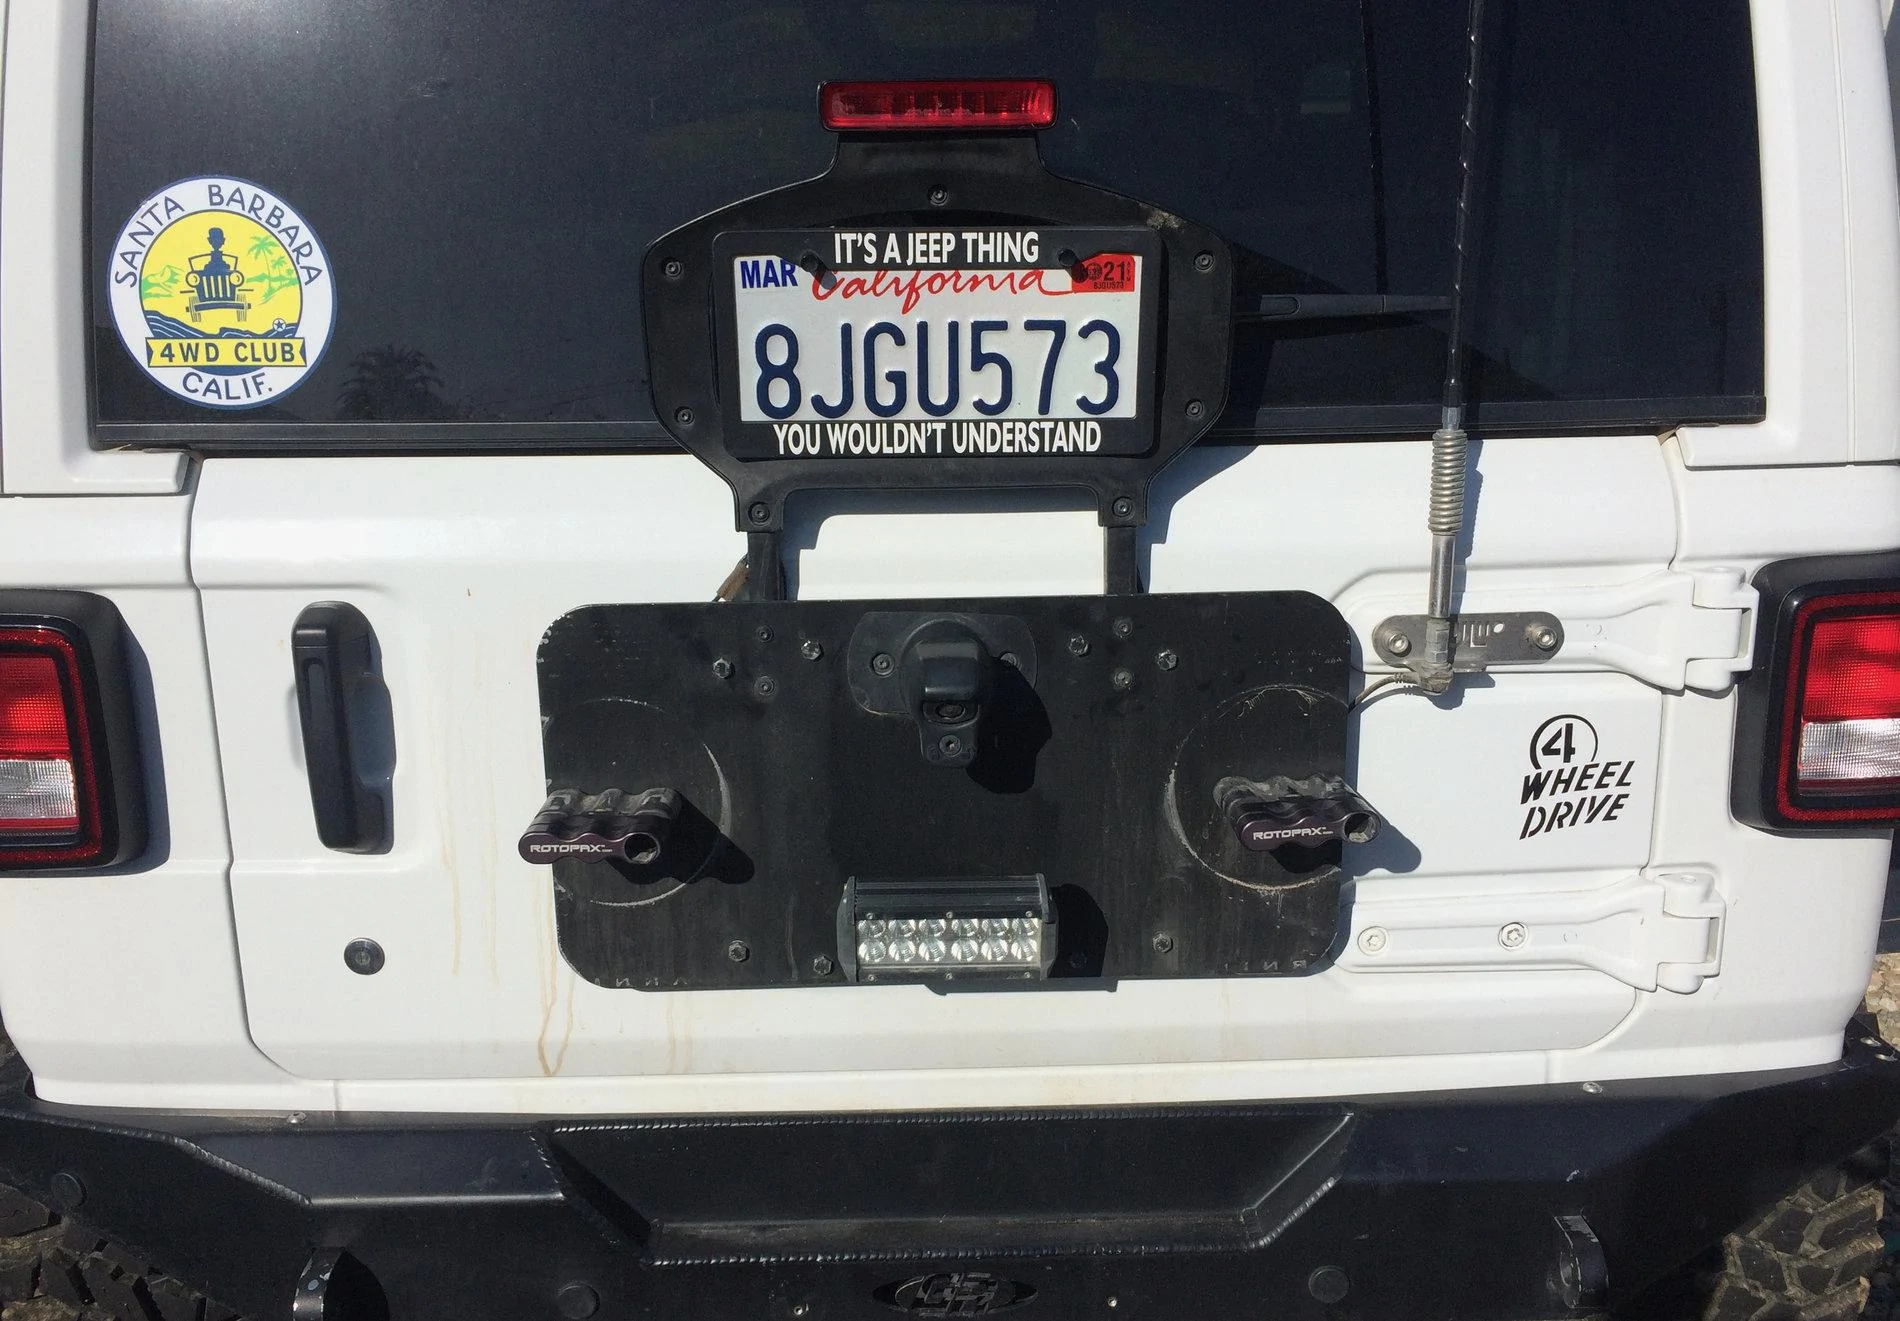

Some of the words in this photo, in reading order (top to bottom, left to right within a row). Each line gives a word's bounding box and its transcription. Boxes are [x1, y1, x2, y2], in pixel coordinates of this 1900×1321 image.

[115, 196, 185, 288] SANTA
[207, 184, 323, 286] BARBARA
[834, 234, 876, 264] IT'S
[883, 233, 902, 263] A
[906, 233, 954, 265] JEEP
[961, 232, 1040, 263] THING
[740, 260, 799, 289] MAR
[1103, 261, 1125, 282] 21
[160, 342, 220, 363] 4WD
[234, 342, 295, 363] CLUB
[754, 319, 1121, 420] 8JGU573
[182, 371, 273, 400] CALIF.
[773, 424, 825, 455] YOU
[827, 422, 945, 455] WOULDN'T
[952, 420, 1101, 453] UNDERSTAND
[1541, 723, 1576, 763] 4
[1520, 760, 1635, 805] WHEEL
[1519, 793, 1630, 840] DRIVE
